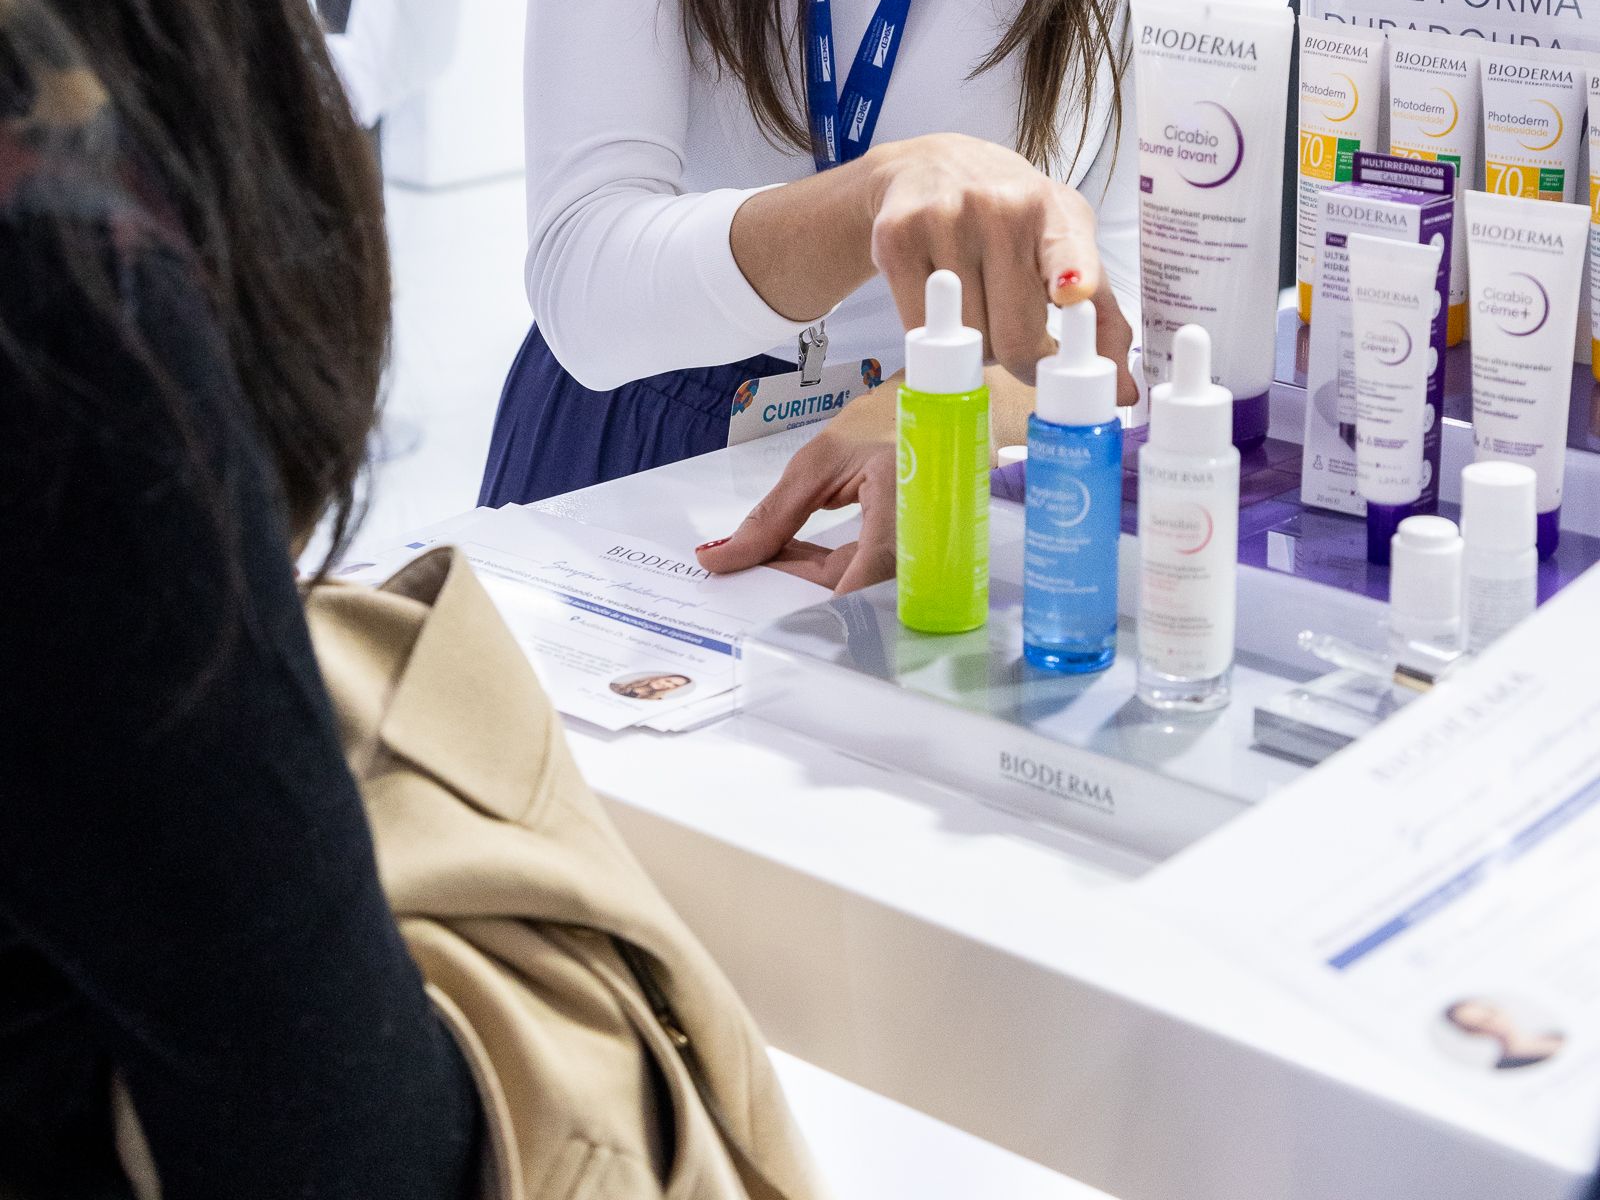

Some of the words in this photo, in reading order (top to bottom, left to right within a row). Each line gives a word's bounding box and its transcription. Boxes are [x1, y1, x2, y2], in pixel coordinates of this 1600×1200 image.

[1141, 25, 1258, 60] BIODERMA
[1305, 37, 1369, 58] BIODERMA
[1396, 51, 1467, 72] BIODERMA
[1488, 63, 1573, 83] BIODERMA
[1301, 82, 1346, 100] Photoderm
[1393, 97, 1445, 115] Photoderm
[1488, 111, 1549, 127] Photoderm
[1164, 124, 1219, 148] Cicabio
[1176, 145, 1217, 165] lavant
[1301, 133, 1325, 167] 70
[1360, 157, 1445, 177] MULTIRREPARADOR
[1490, 164, 1524, 197] 70
[1326, 202, 1408, 227] BIODERMA
[1472, 222, 1564, 248] BIODERMA
[1357, 287, 1420, 304] BIODERMA
[1483, 286, 1534, 306] Cicabio
[763, 390, 845, 423] CURITIBA
[606, 545, 712, 580] BIODERMA
[1000, 751, 1115, 805] BIODERMA
